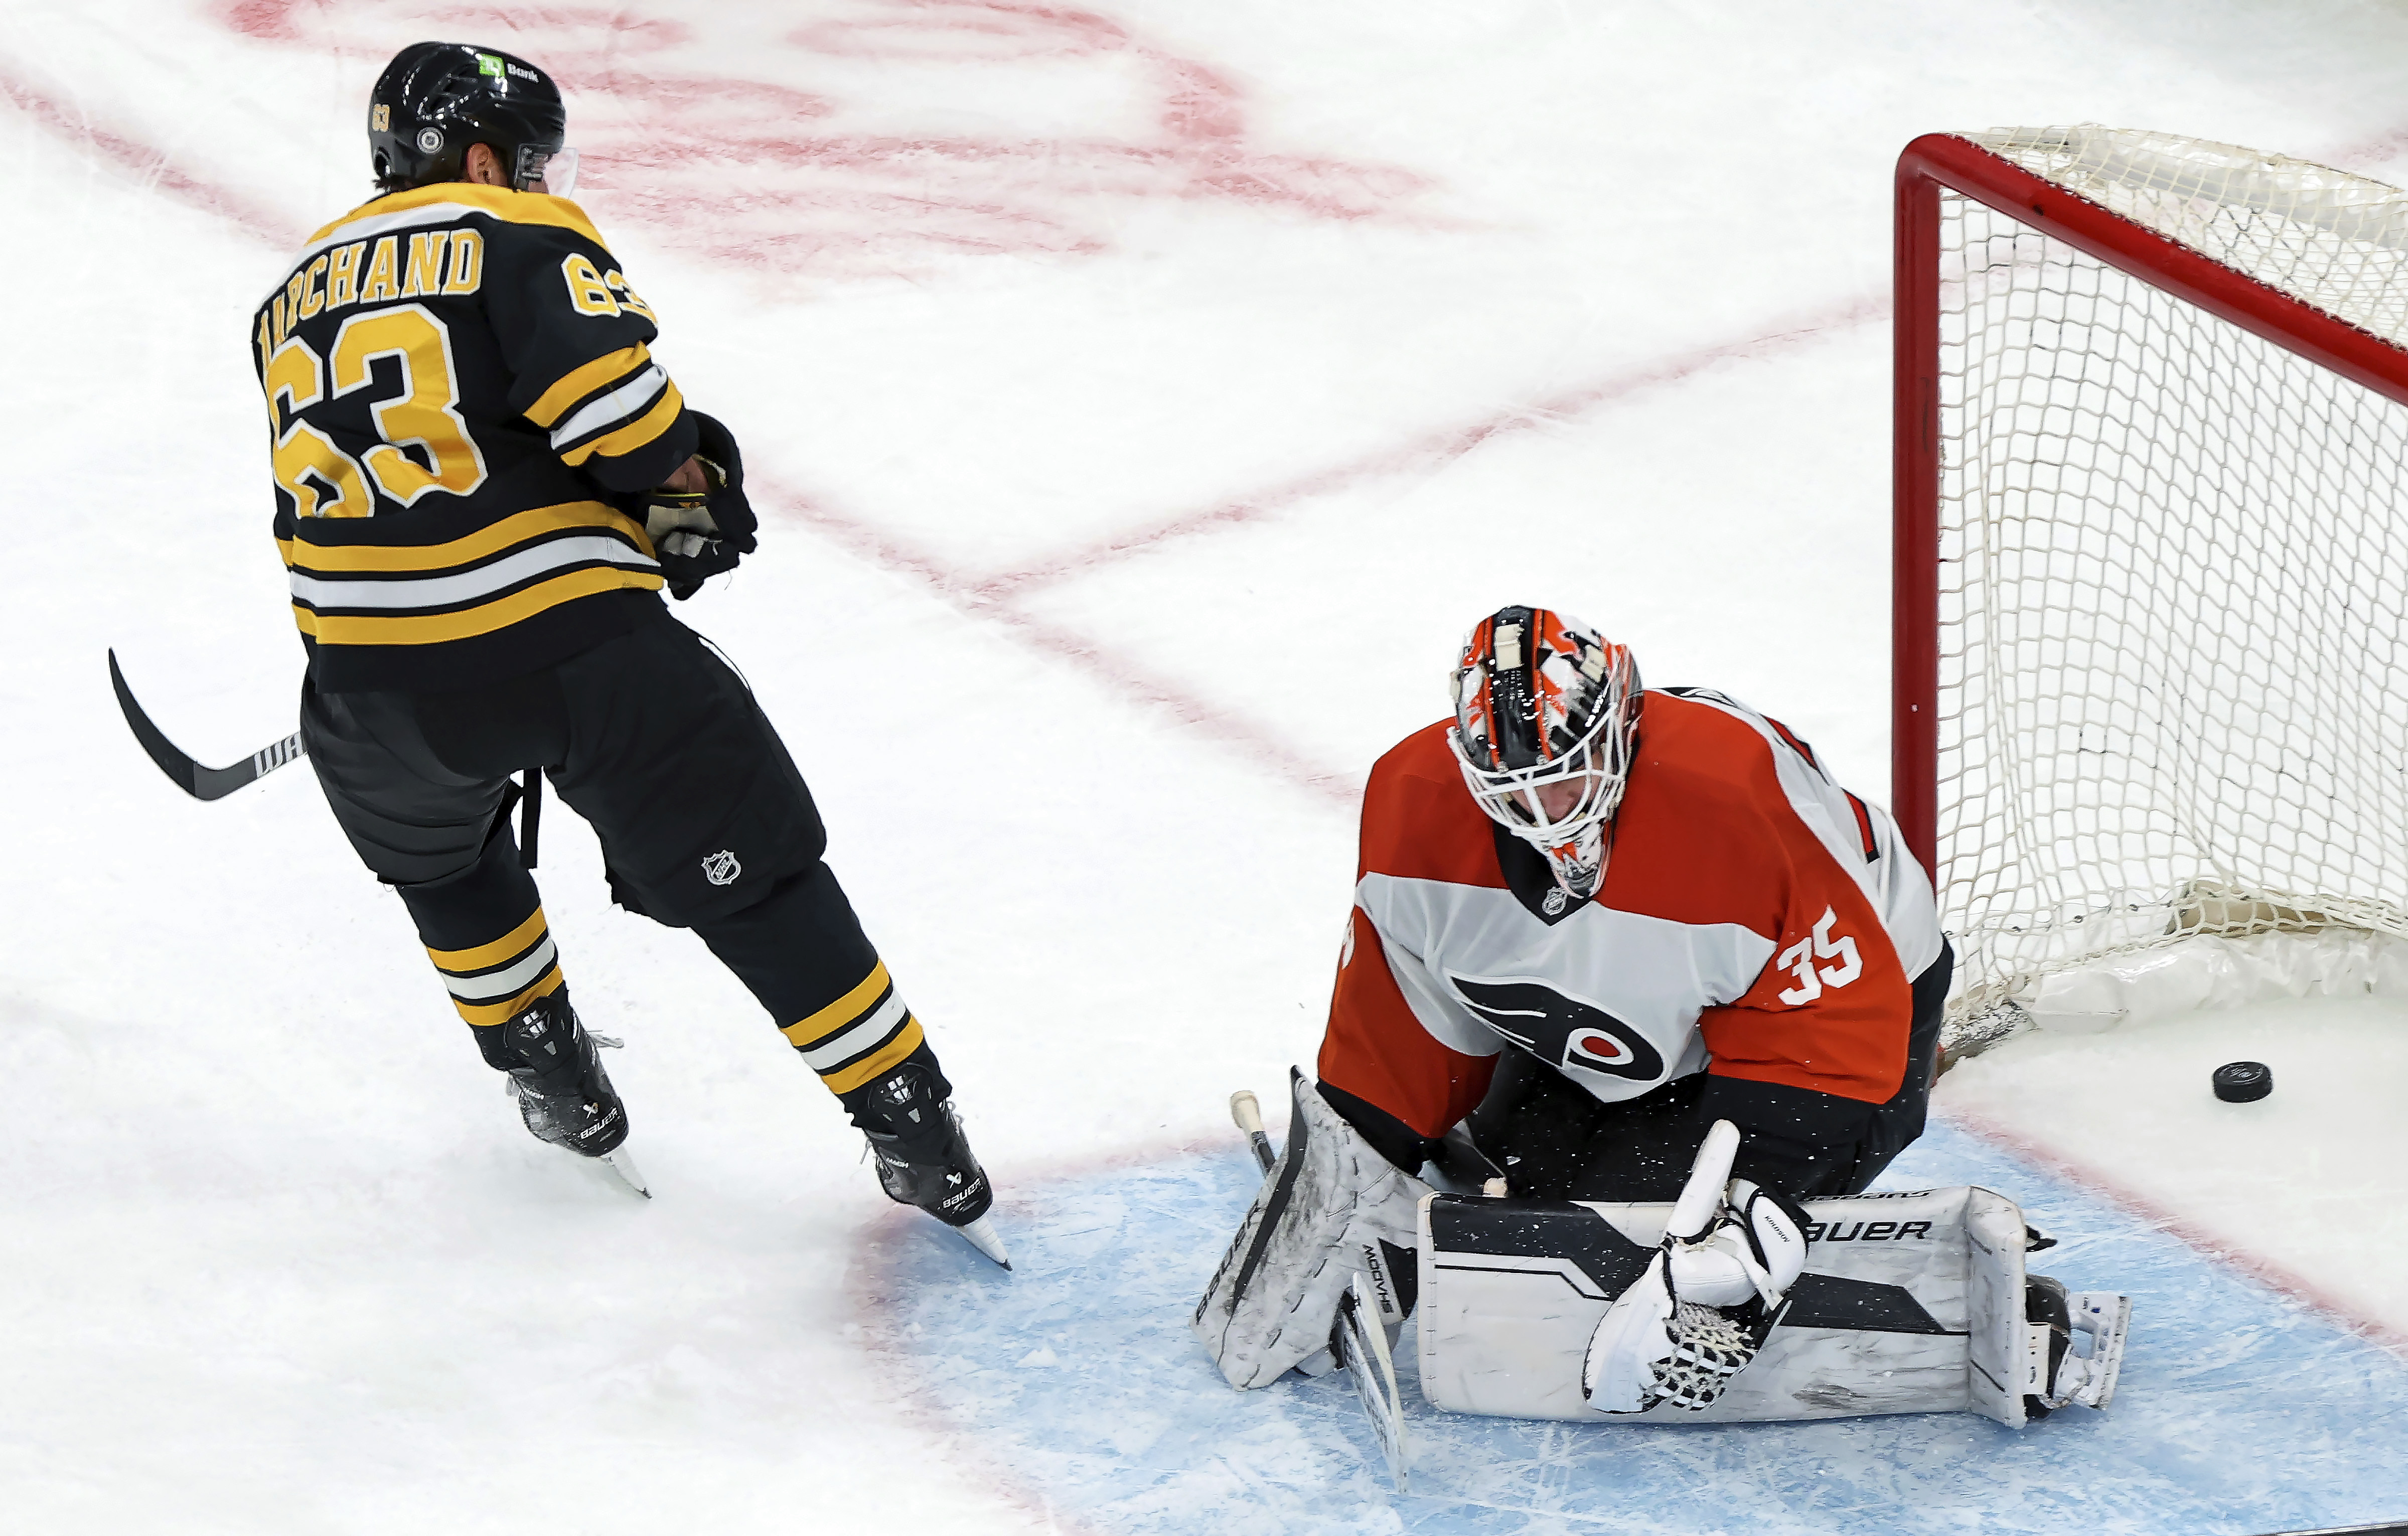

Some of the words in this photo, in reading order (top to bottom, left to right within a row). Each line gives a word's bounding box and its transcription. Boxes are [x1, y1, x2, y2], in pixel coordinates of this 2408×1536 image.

[507, 63, 539, 83] Bank
[560, 252, 658, 329] 63
[267, 302, 489, 520] 63
[1776, 904, 1864, 1006] 35
[1805, 1221, 1932, 1242] AUER
[1362, 1244, 1395, 1313] SHADOW
